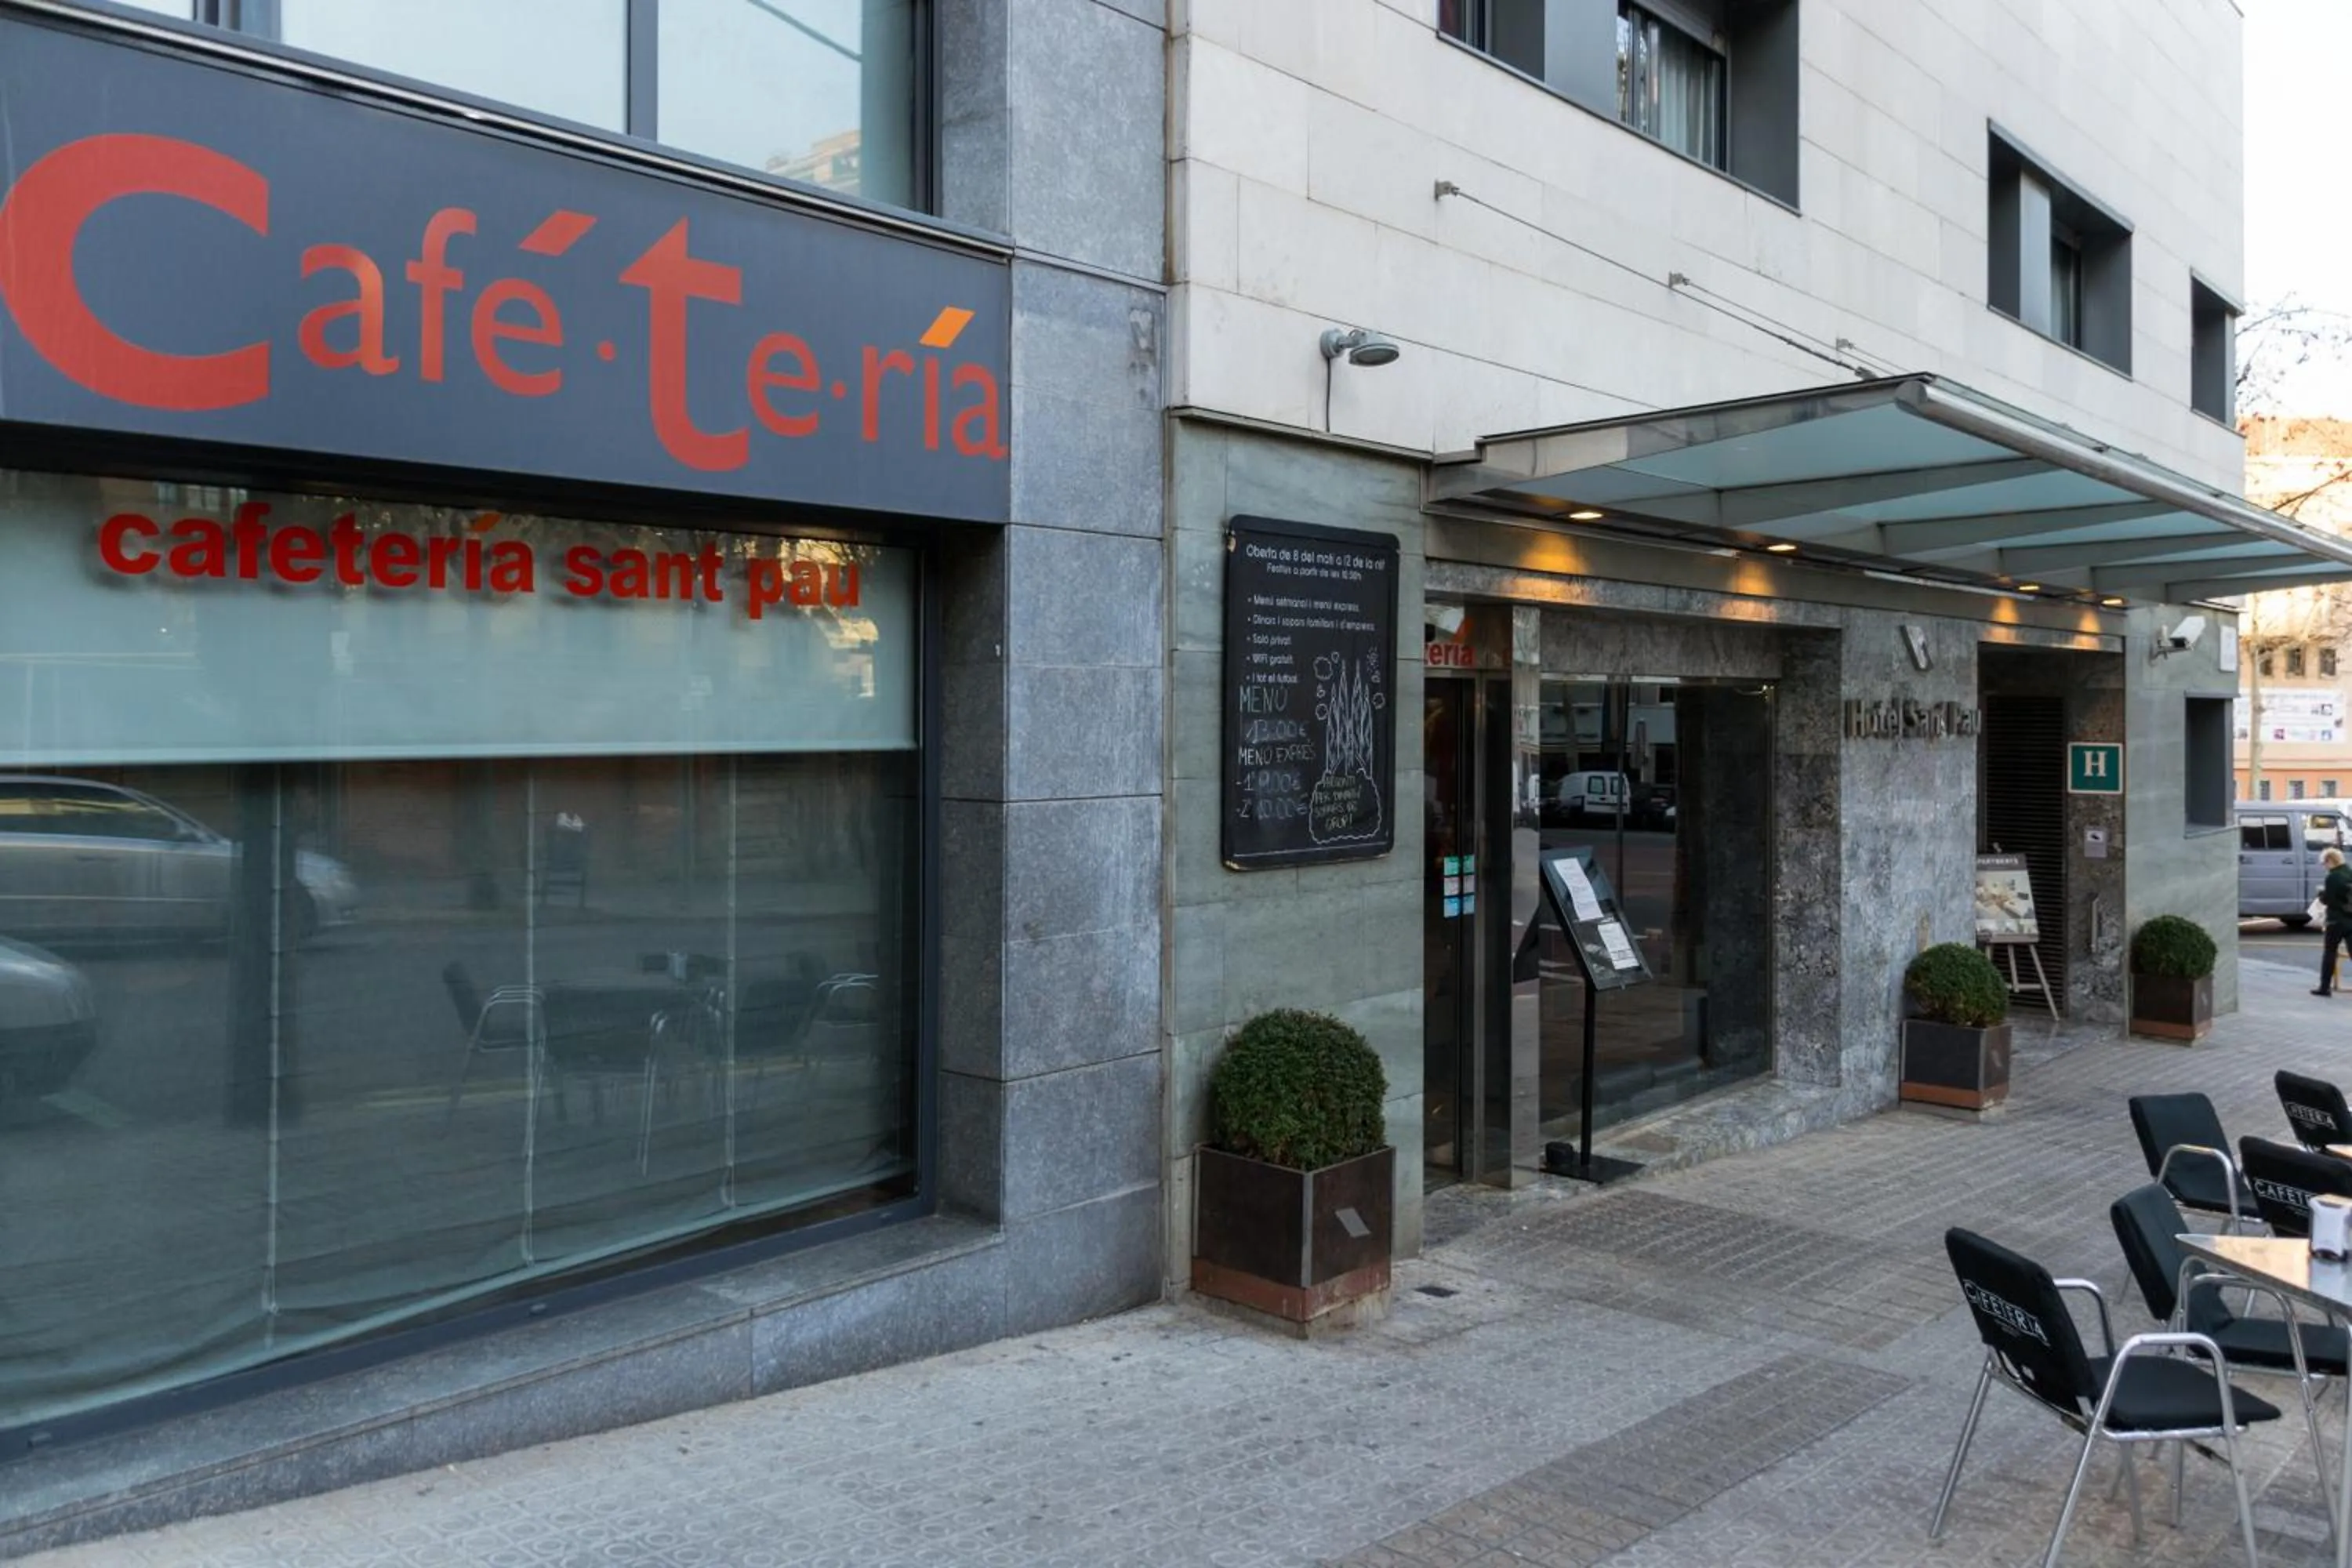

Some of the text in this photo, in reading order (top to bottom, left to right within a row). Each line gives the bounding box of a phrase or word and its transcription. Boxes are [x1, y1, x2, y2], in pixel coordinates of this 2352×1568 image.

[99, 502, 860, 619] cafetería sant pau
[1279, 549, 1290, 561] de
[1293, 550, 1299, 561] 8
[1301, 550, 1315, 563] del
[1335, 556, 1342, 565] a
[1353, 556, 1363, 568] de
[1365, 557, 1373, 570] la
[2083, 750, 2107, 776] H
